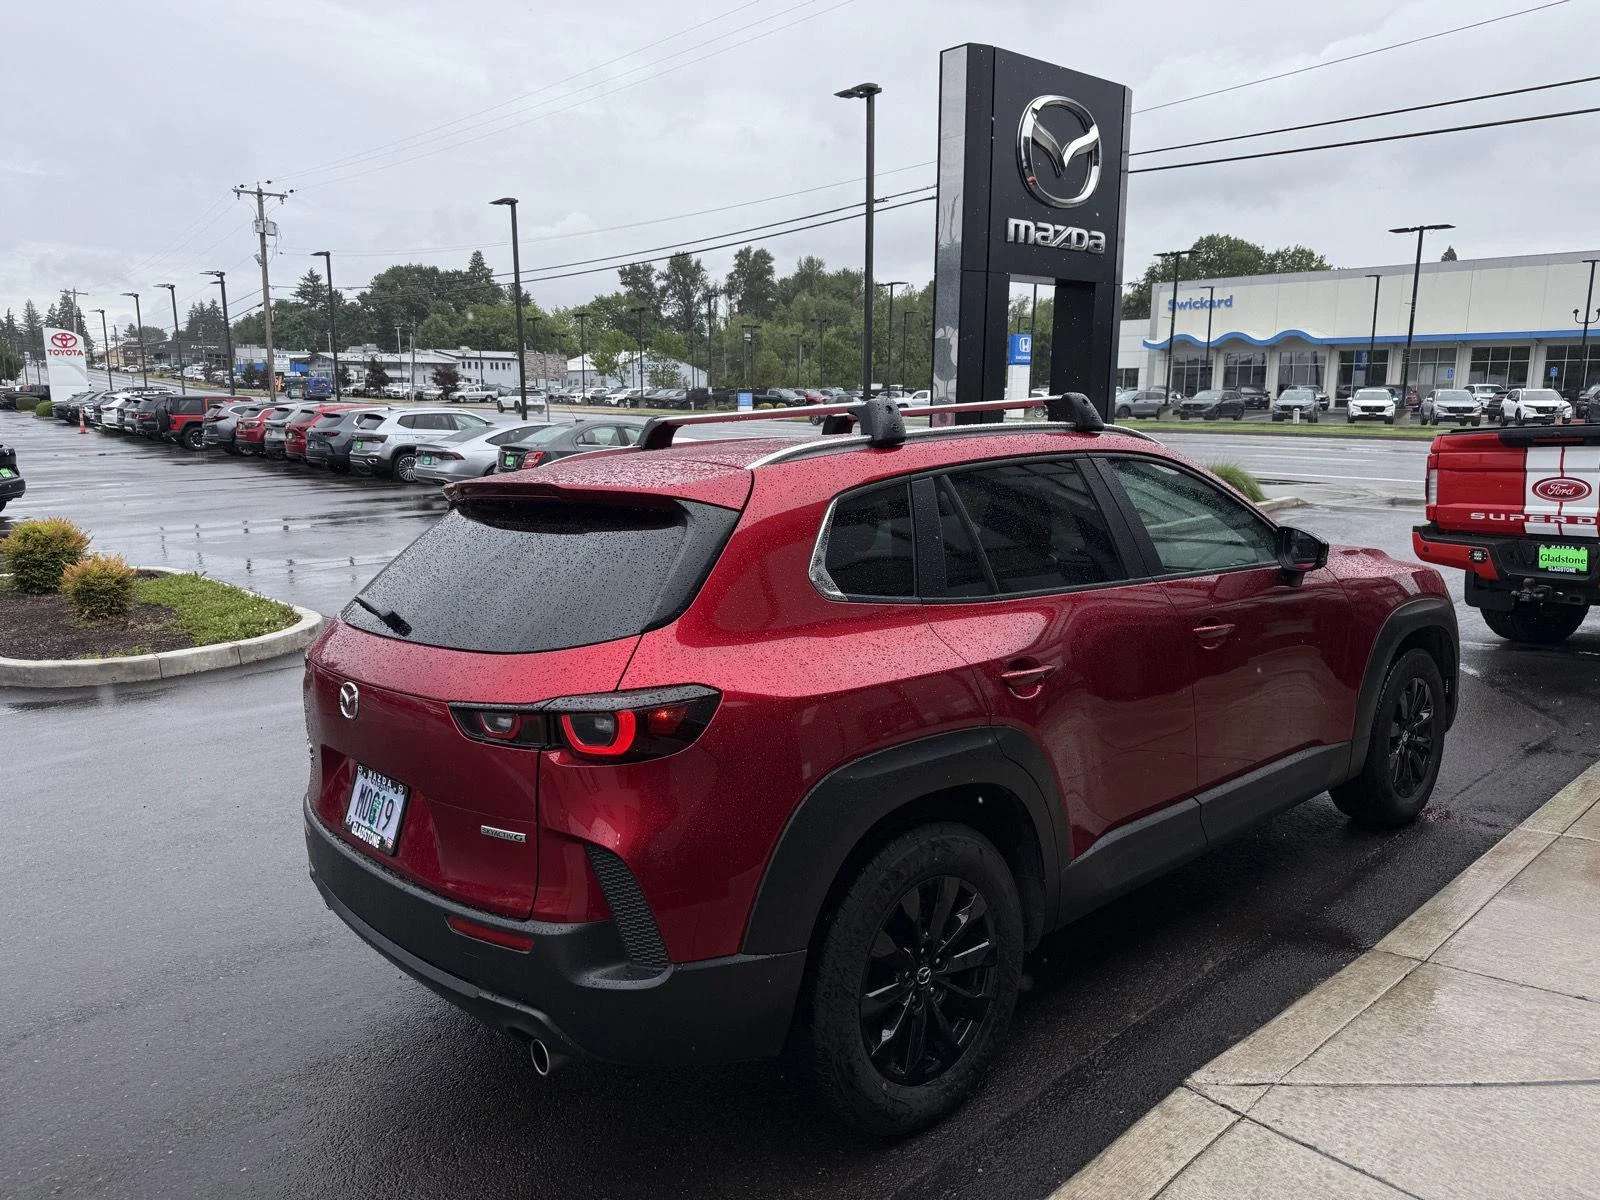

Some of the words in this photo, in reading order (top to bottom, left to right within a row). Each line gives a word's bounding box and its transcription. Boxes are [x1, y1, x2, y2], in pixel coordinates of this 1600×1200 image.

[1167, 294, 1234, 311] Swickard
[1547, 483, 1576, 496] Ford
[1470, 512, 1567, 524] SUPER
[1540, 553, 1587, 565] Gladstone
[368, 769, 393, 787] MAZDA
[351, 821, 381, 849] GLADSTONE
